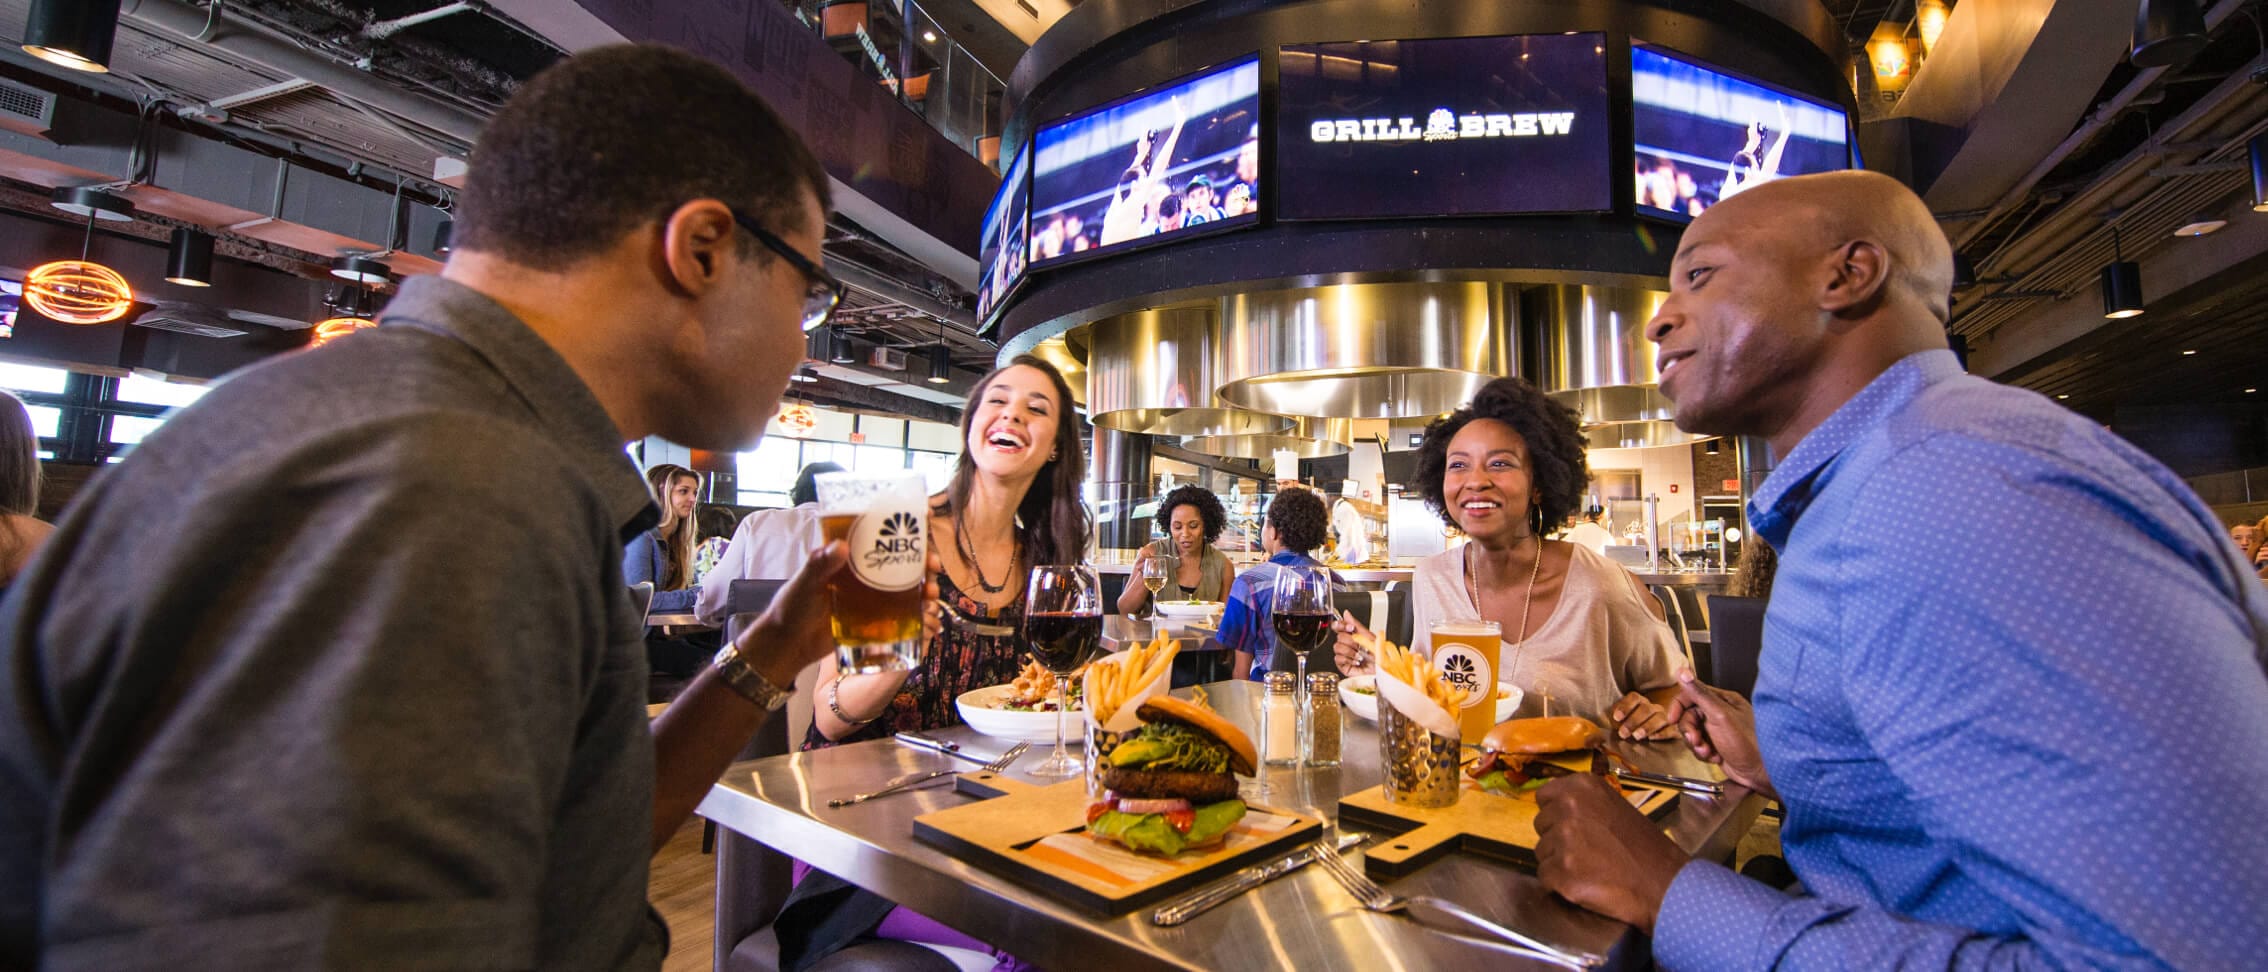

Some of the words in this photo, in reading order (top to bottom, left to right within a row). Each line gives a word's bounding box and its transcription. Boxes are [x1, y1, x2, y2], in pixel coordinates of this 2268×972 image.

[1311, 118, 1421, 142] GRILL
[1459, 113, 1574, 138] BREW
[875, 537, 921, 553] NBC
[1442, 671, 1476, 684] NBC
